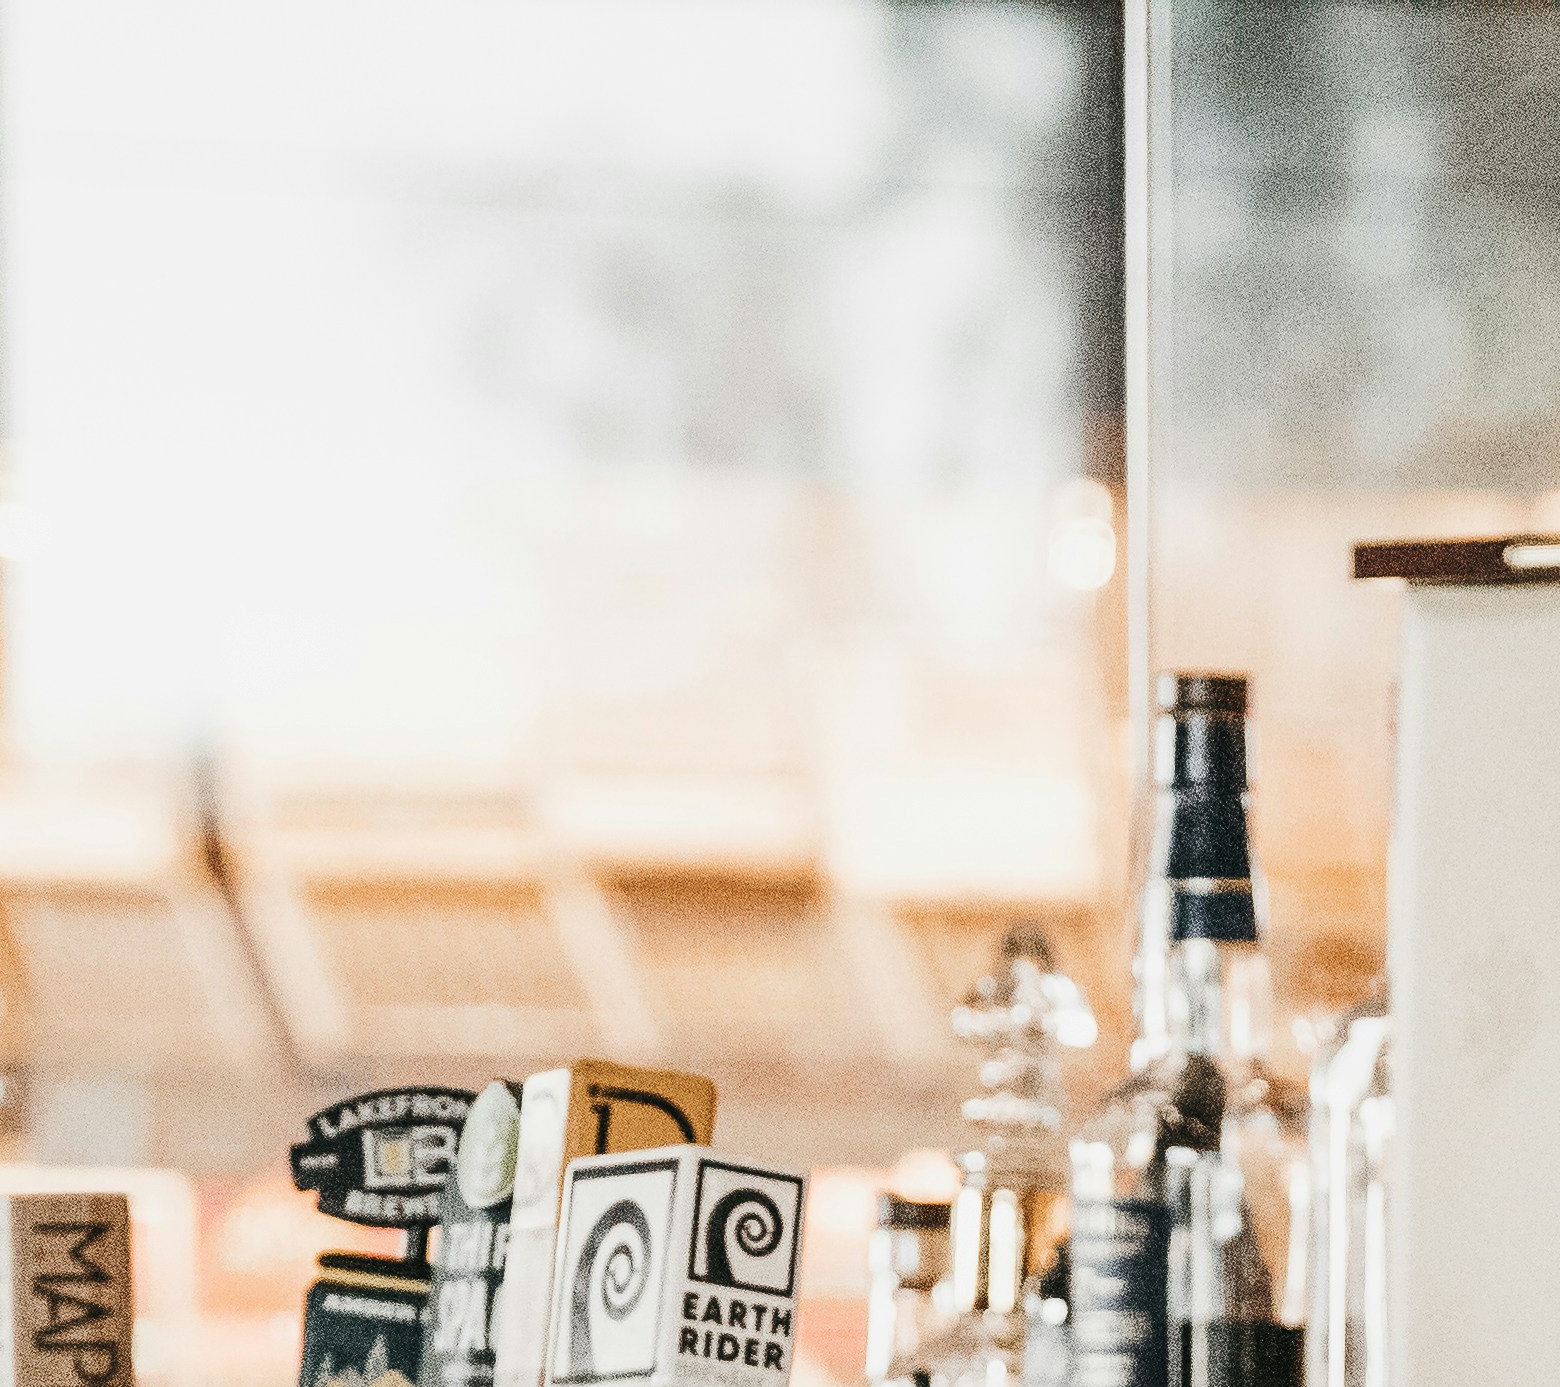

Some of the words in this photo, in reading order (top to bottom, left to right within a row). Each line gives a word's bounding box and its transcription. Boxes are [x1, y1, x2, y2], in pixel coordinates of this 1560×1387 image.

[319, 1094, 474, 1138] LAKEFRON
[682, 1293, 794, 1338] EARTH
[678, 1327, 785, 1372] RIDER
